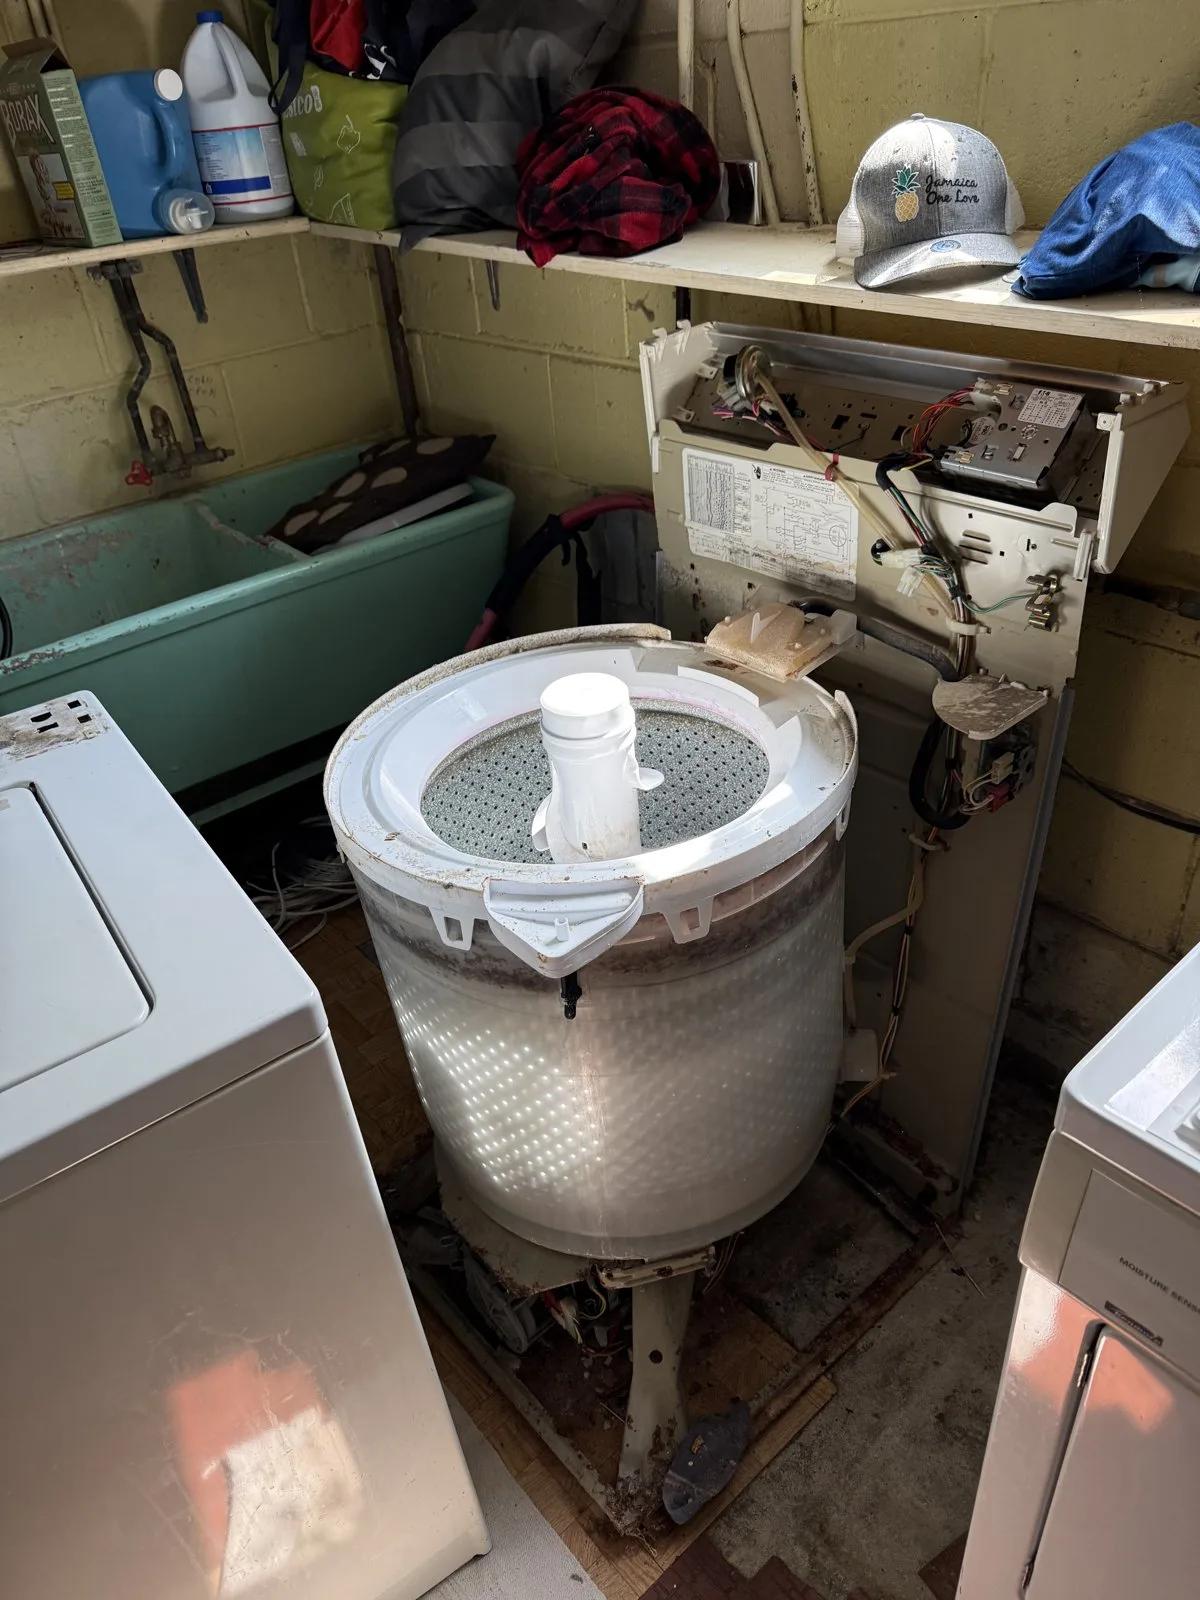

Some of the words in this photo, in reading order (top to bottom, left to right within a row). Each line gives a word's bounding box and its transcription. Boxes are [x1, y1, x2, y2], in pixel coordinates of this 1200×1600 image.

[0, 94, 55, 149] BORAX
[925, 174, 978, 194] Jamaica
[926, 191, 953, 205] One
[955, 189, 980, 203] Love
[1119, 1256, 1169, 1293] MOISTURE
